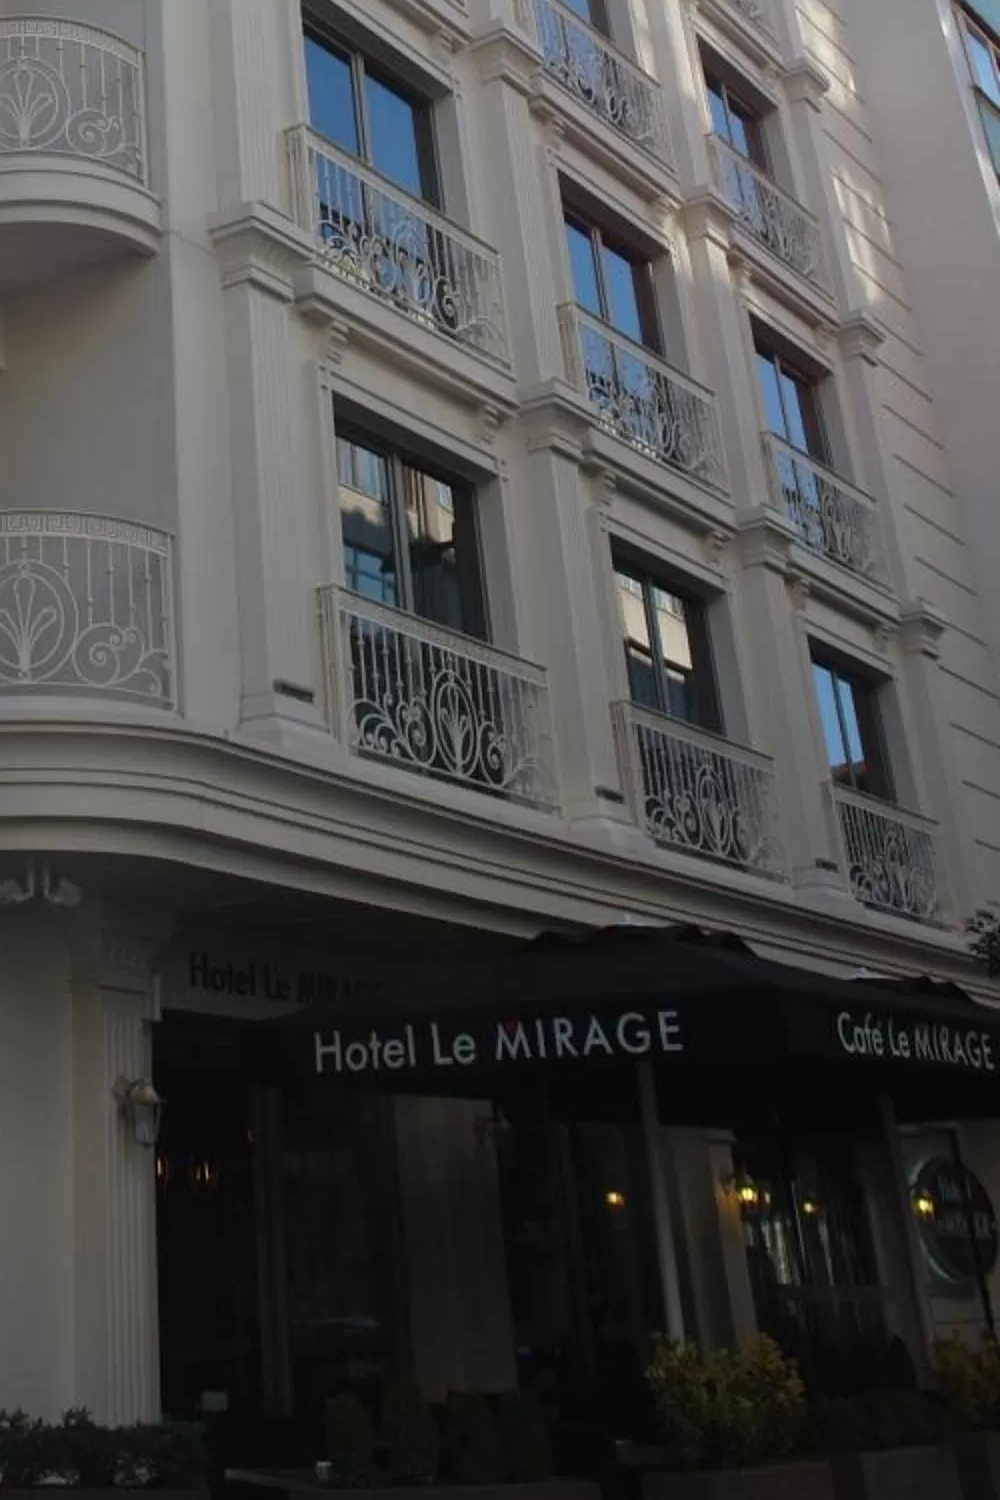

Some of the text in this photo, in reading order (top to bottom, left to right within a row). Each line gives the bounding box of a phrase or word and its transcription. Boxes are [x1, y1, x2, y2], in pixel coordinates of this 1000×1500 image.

[188, 951, 255, 997] Hotel
[263, 963, 291, 1000] Le
[314, 1010, 685, 1074] Hotel Le MIRAGE
[837, 1011, 996, 1070] Café Le MIRAGE
